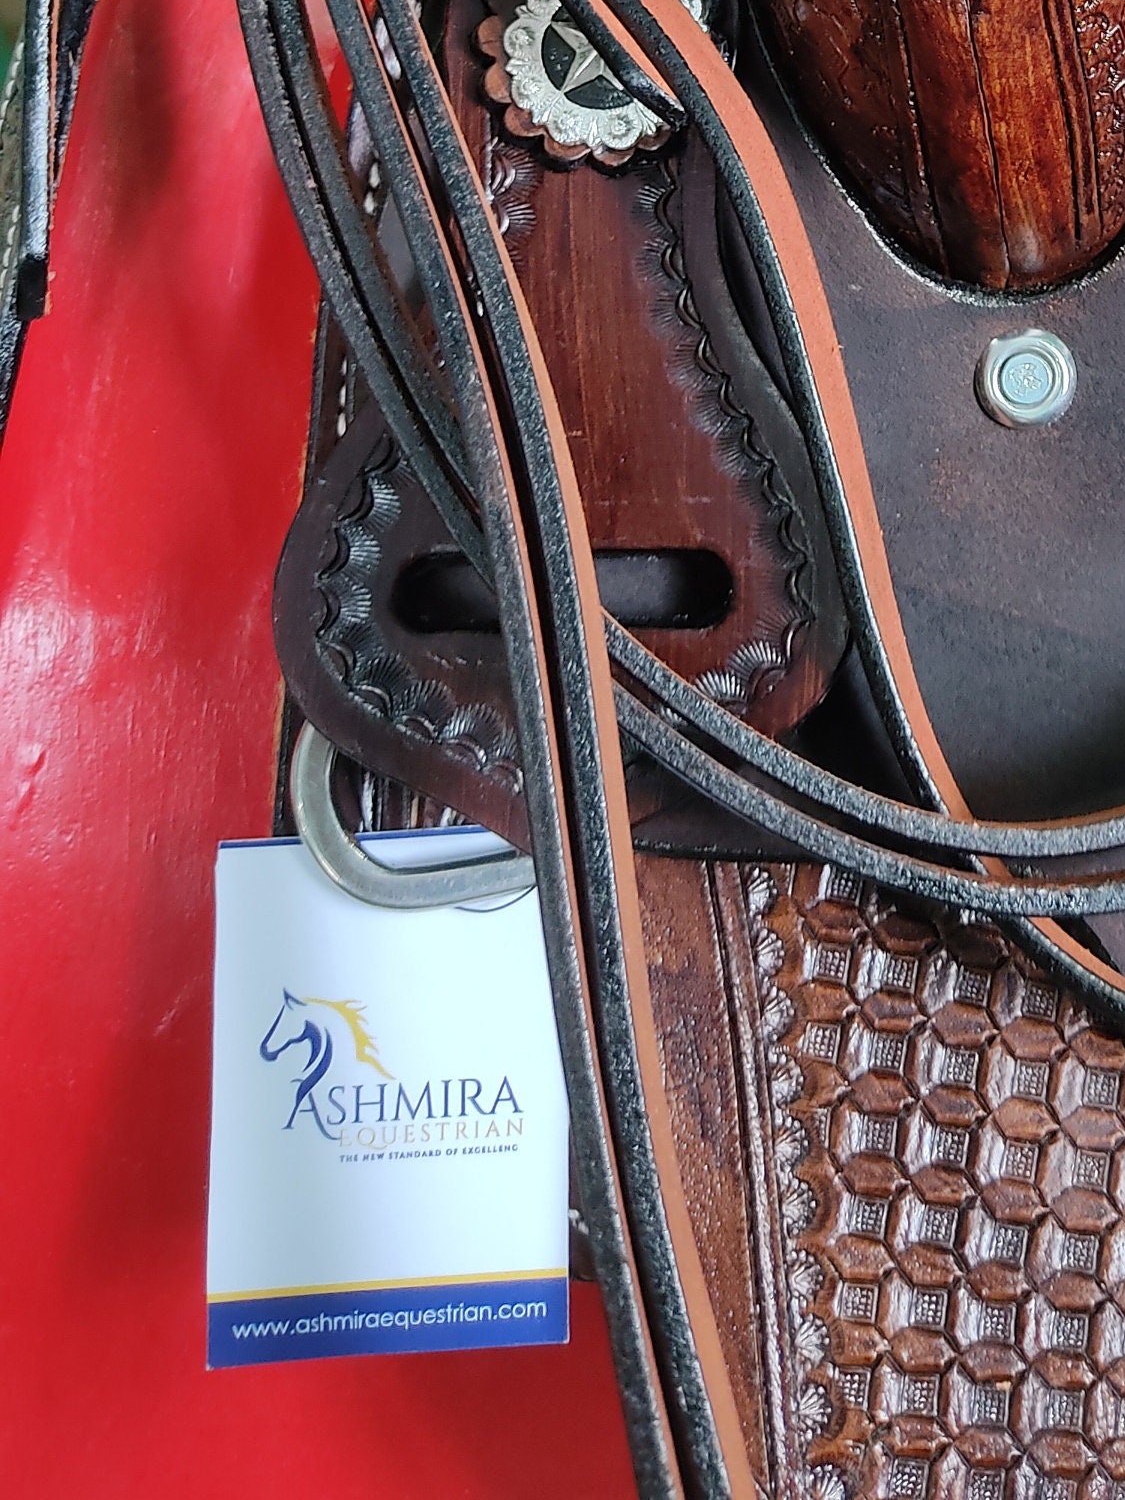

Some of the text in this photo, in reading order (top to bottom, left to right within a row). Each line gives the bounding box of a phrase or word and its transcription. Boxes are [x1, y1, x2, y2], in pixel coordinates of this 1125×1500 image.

[282, 1076, 524, 1140] ASHMIRA
[339, 1118, 524, 1150] EQUESTRIAN
[340, 1154, 358, 1163] THE
[363, 1152, 385, 1162] NEW
[388, 1150, 442, 1160] STANDARD
[446, 1148, 458, 1156] OF
[232, 1300, 547, 1339] www.ashmiraequestrian.com
